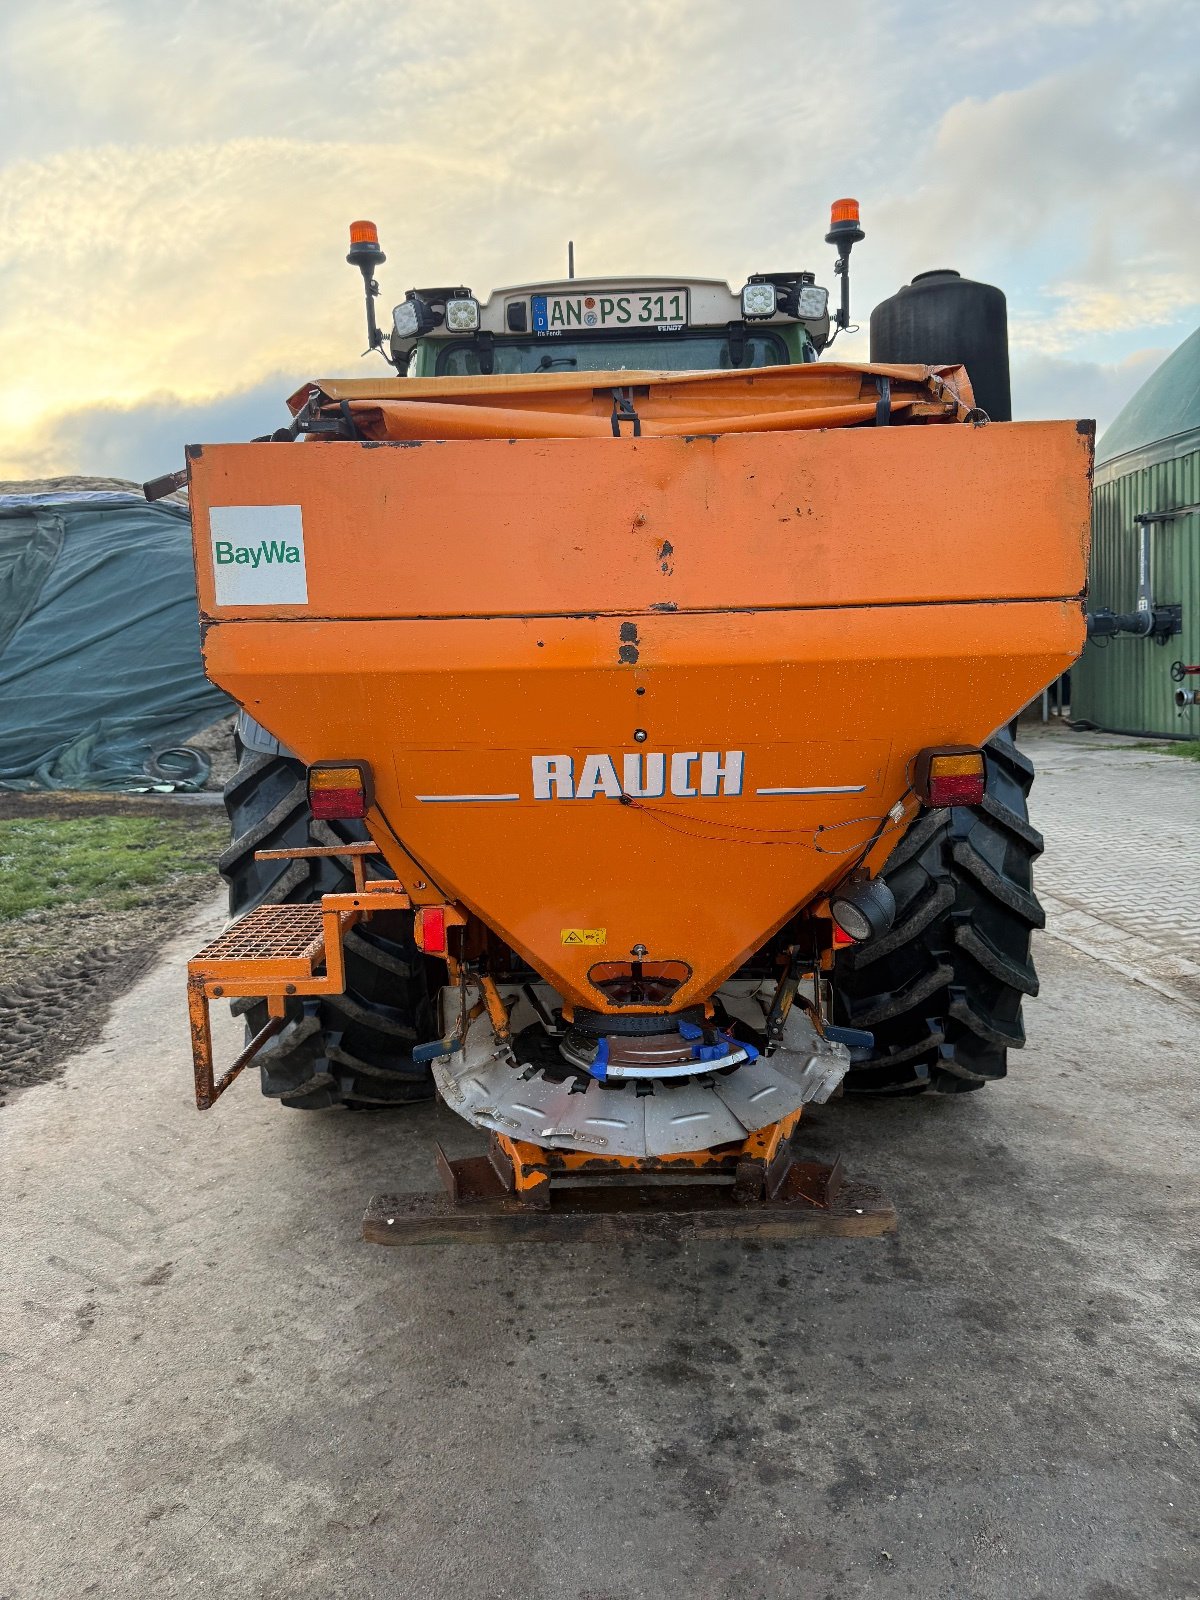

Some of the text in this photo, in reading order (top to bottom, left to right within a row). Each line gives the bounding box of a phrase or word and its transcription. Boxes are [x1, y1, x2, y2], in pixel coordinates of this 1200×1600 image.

[538, 318, 544, 326] D
[551, 295, 683, 326] AN PS 311
[657, 324, 683, 332] FENDT
[215, 540, 300, 569] BayWa
[531, 750, 745, 800] RAUCH
